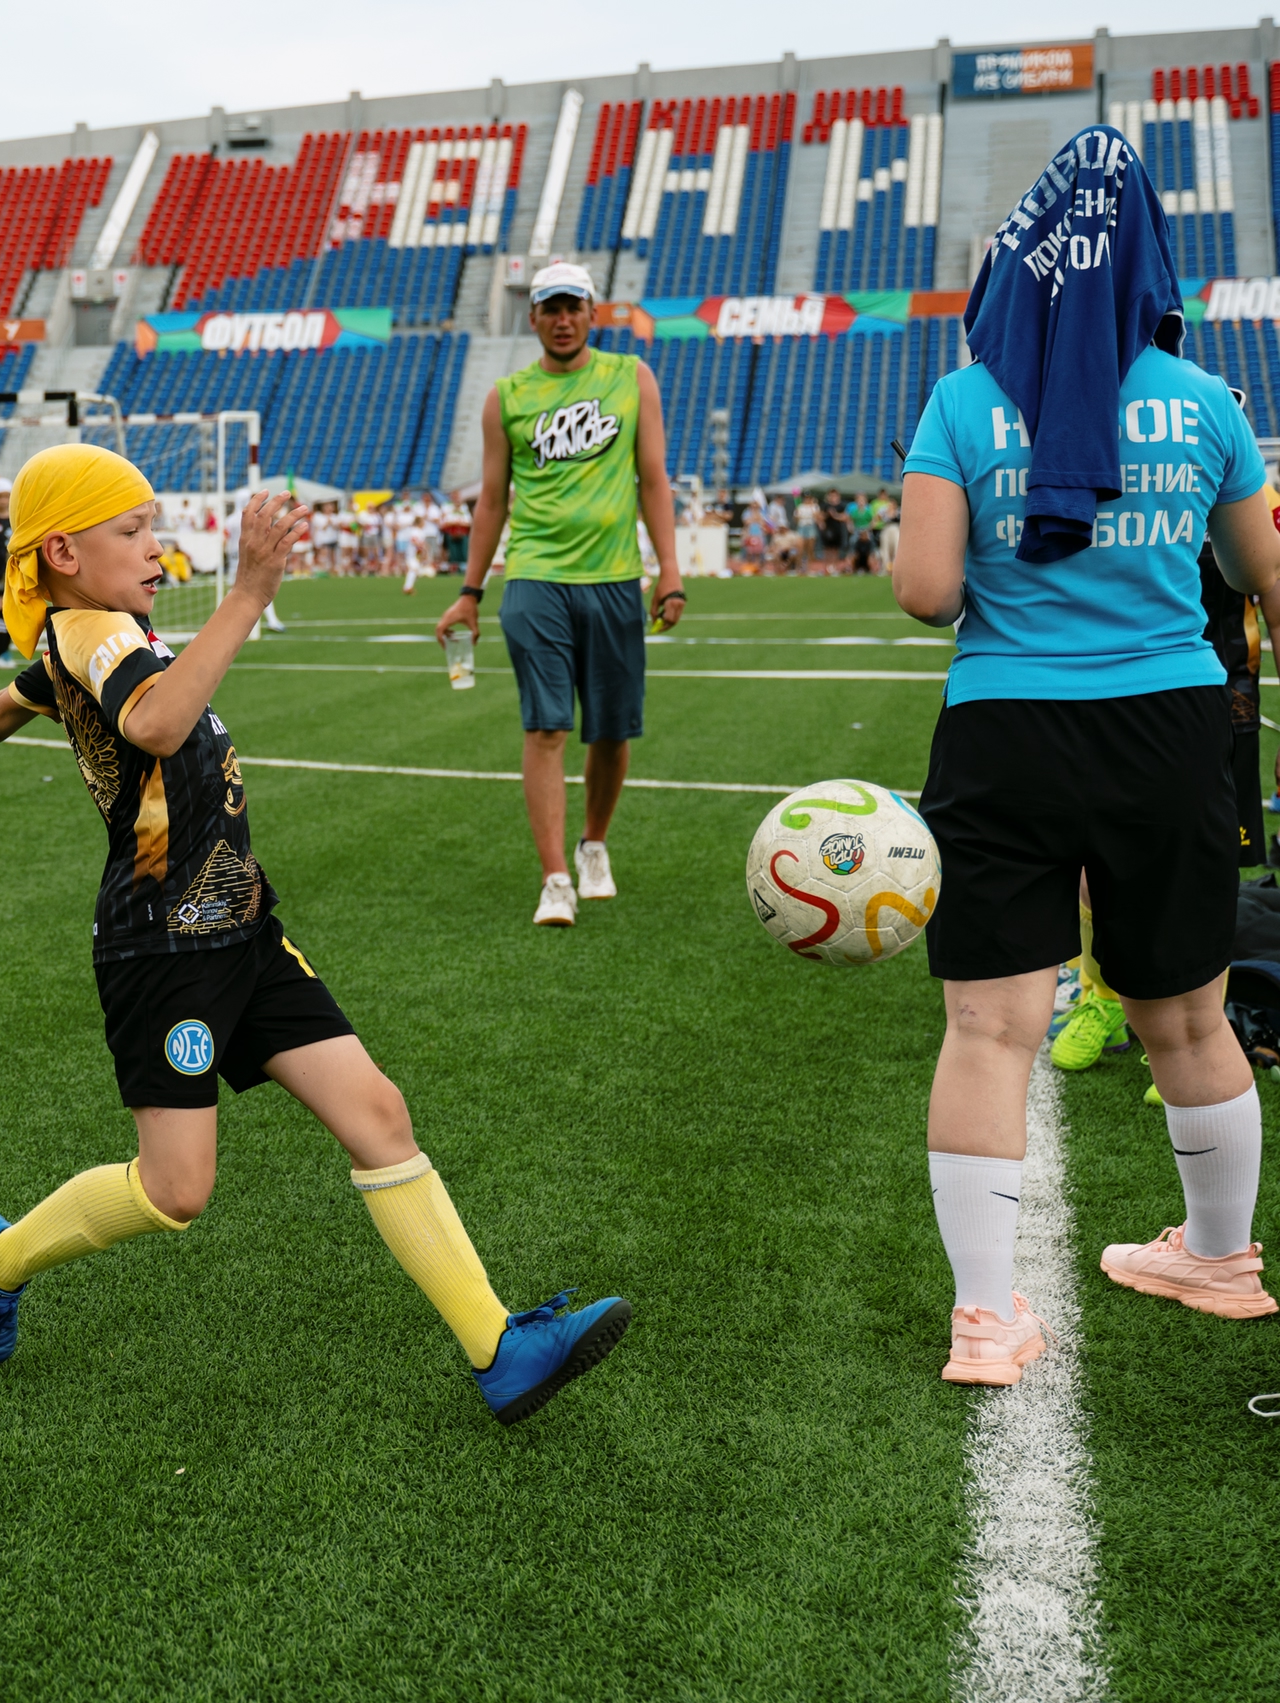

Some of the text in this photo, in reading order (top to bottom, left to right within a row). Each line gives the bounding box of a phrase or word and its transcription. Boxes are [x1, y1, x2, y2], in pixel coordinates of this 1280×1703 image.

[200, 311, 327, 350] ФУТБОЛ
[715, 293, 826, 338] СЕМЬЯ
[991, 398, 1199, 450] НОЕ
